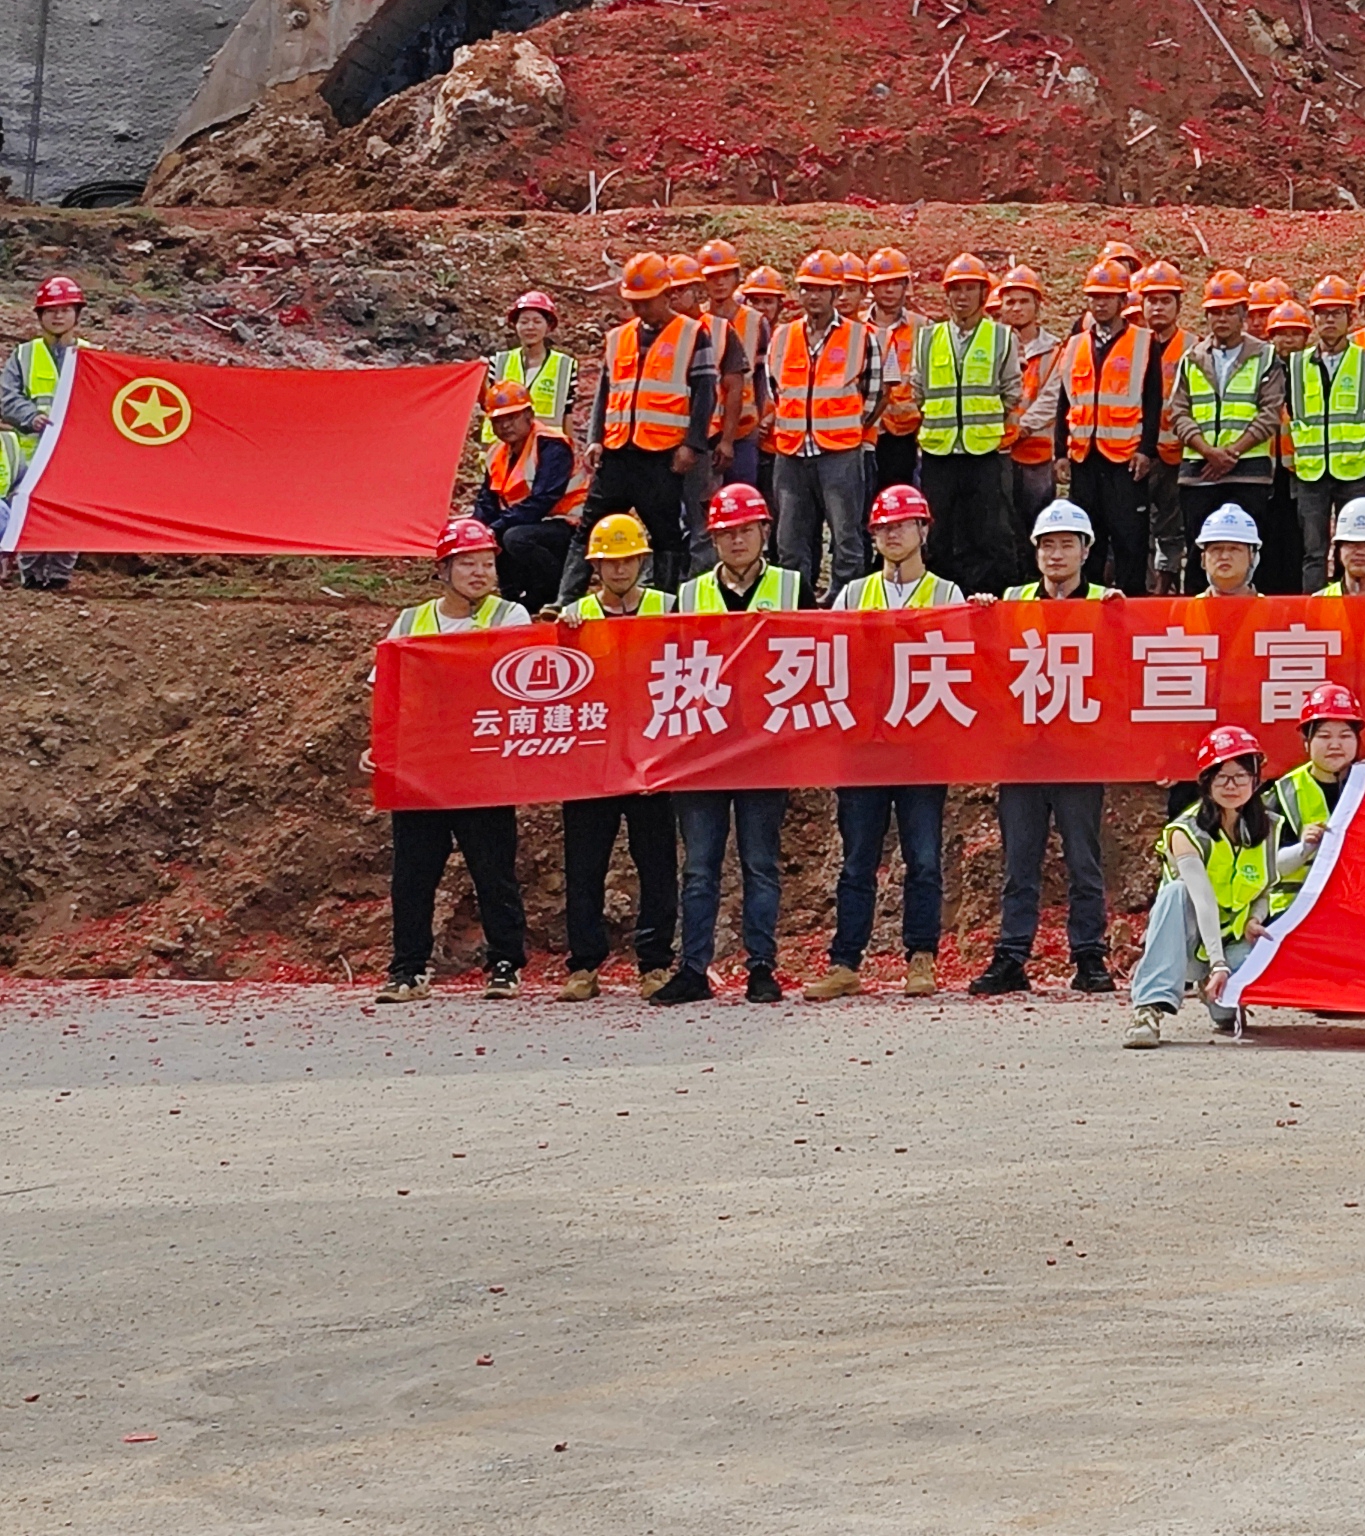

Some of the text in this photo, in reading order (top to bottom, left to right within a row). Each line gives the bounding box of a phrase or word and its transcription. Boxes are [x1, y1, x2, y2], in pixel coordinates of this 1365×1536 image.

[472, 702, 610, 737] 云南建投
[501, 735, 577, 758] YCIH
